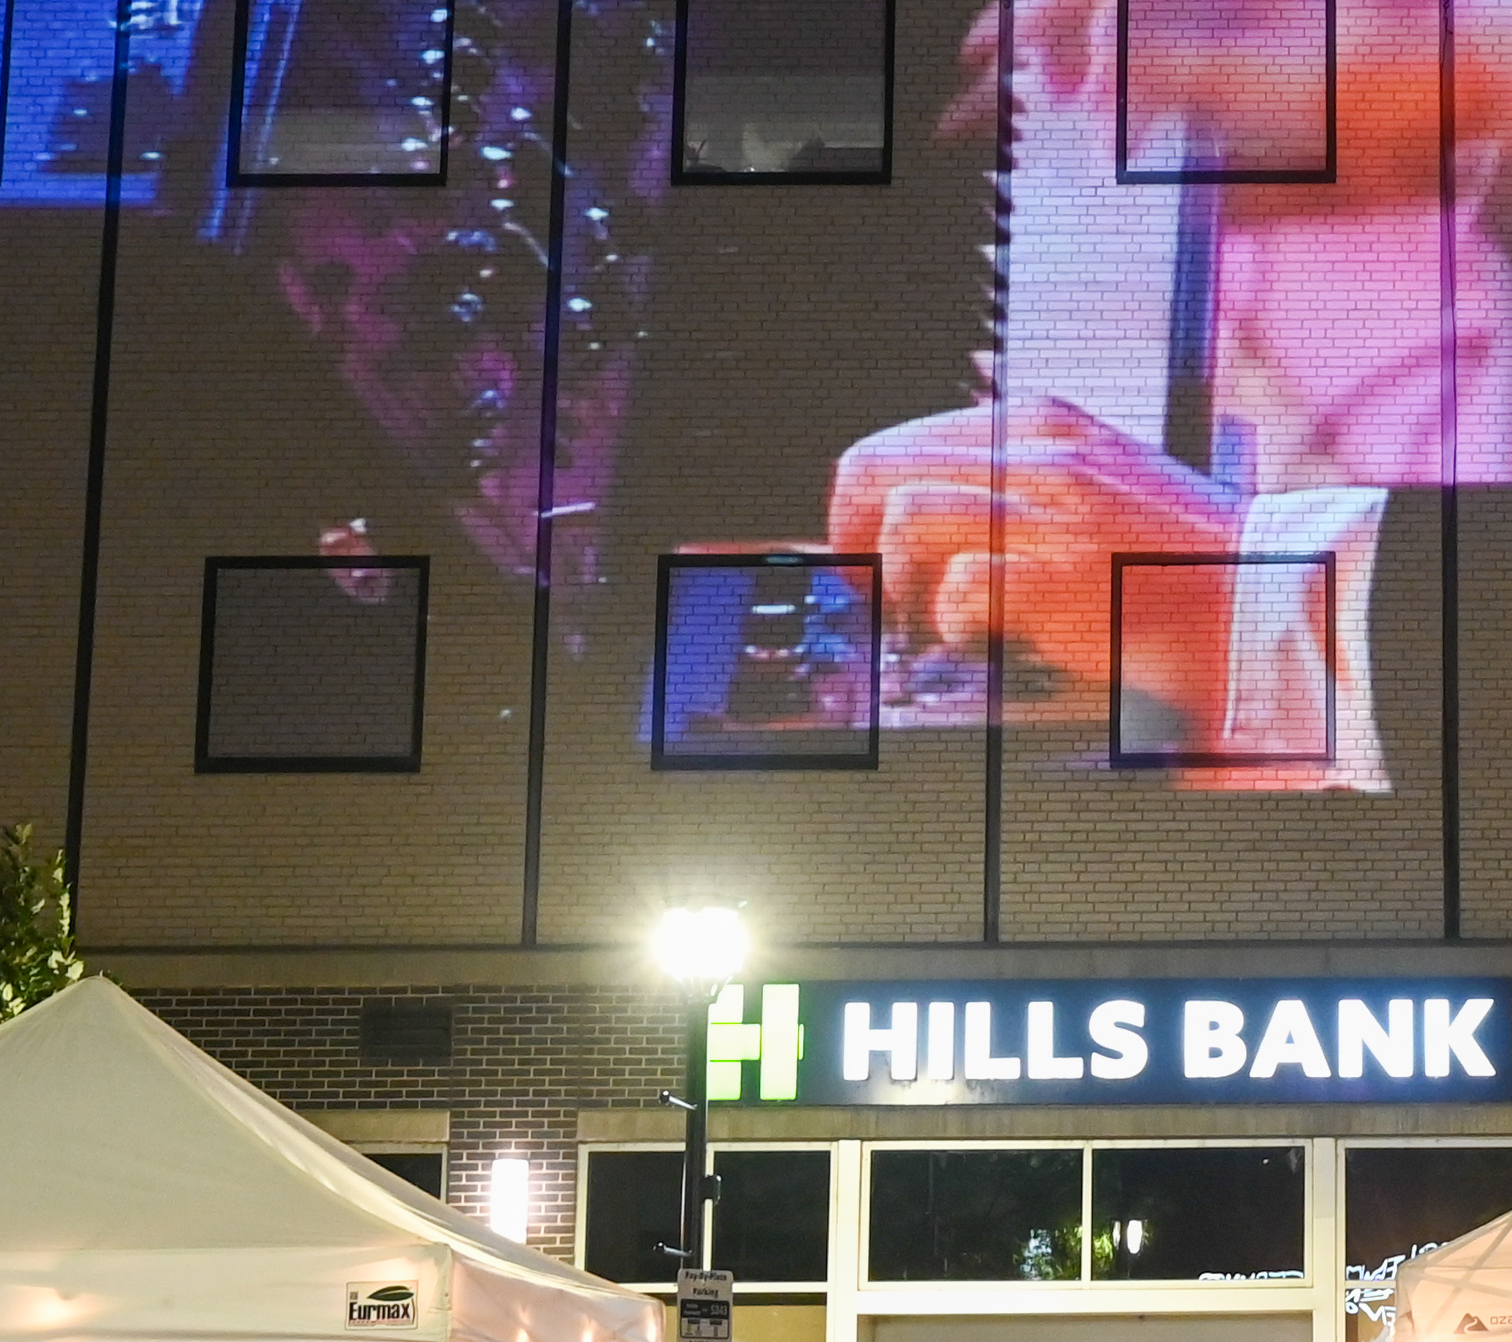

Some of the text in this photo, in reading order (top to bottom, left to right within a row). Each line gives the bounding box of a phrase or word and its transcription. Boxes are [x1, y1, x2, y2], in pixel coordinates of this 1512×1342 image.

[842, 998, 1497, 1082] HILLS BANK
[349, 1302, 410, 1321] Eurmax
